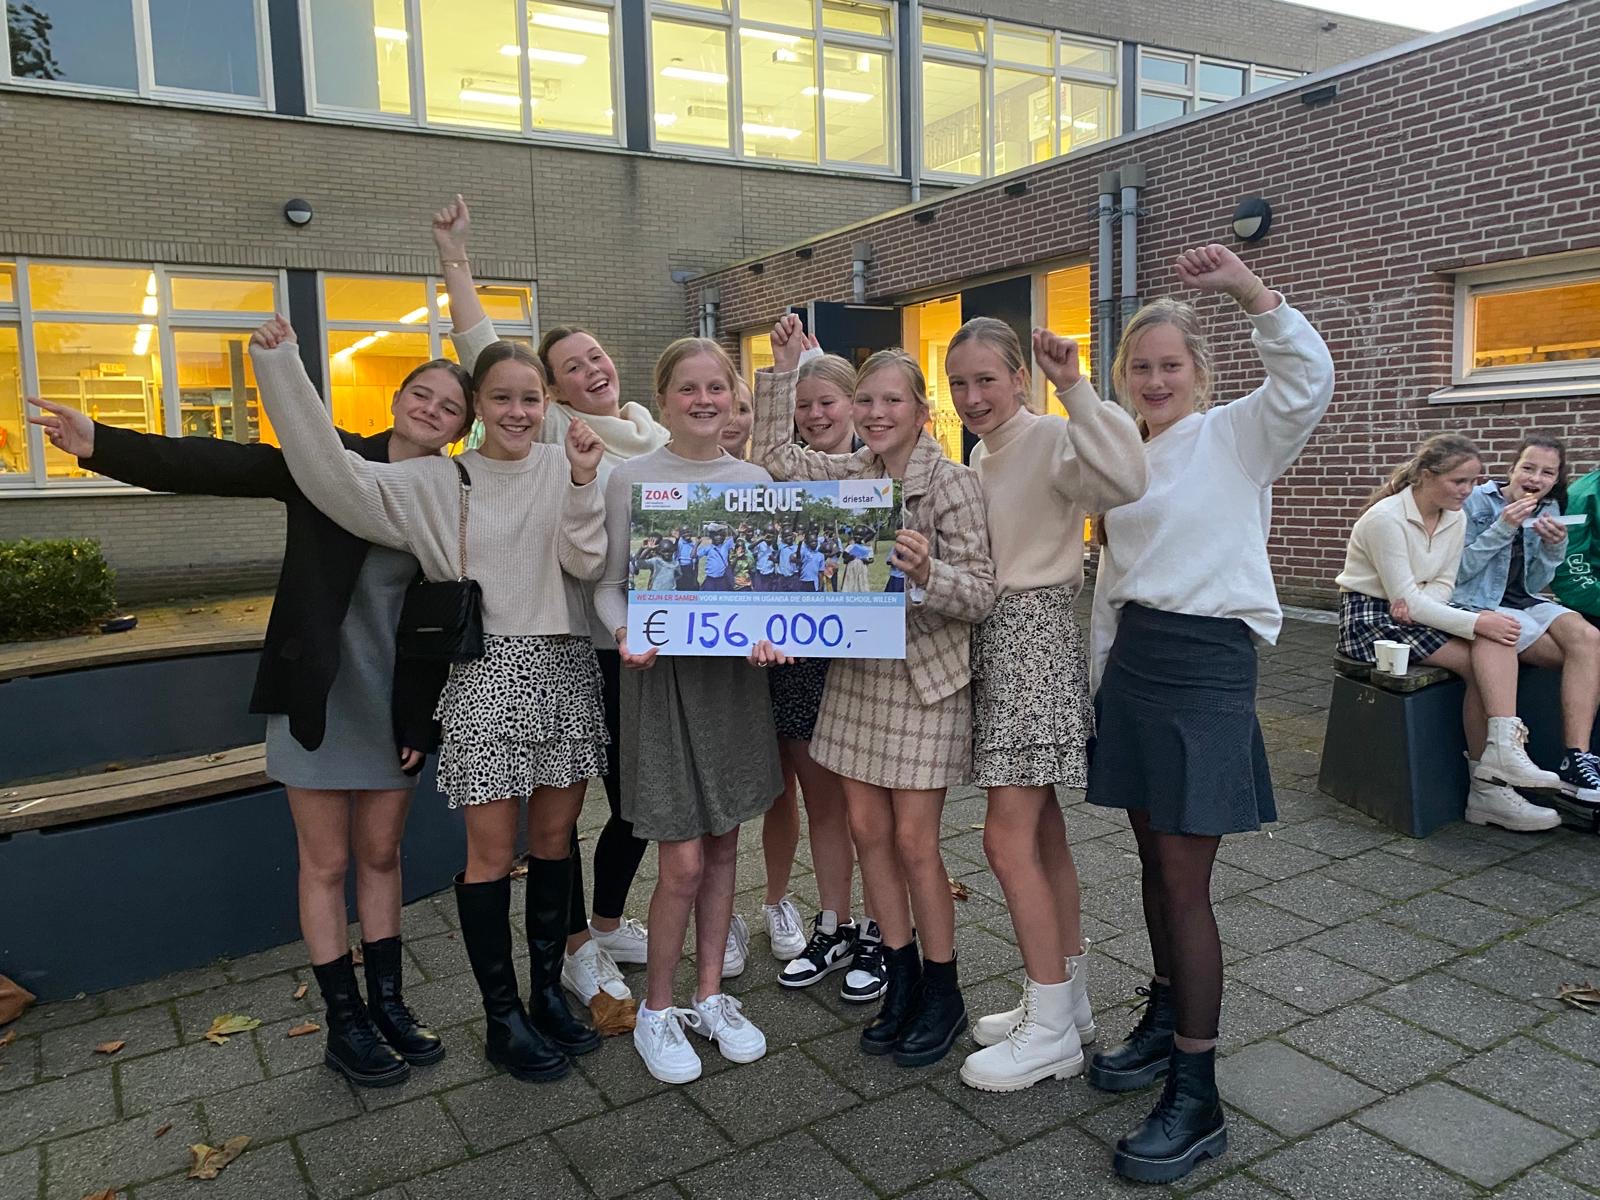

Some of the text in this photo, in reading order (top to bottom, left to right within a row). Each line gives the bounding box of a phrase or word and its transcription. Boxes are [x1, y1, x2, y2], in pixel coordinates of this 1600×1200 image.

[368, 418, 375, 427] 3
[645, 490, 670, 501] ZOA
[842, 494, 875, 504] driestar
[724, 487, 803, 515] CHEQUE
[700, 594, 718, 602] VOOR
[826, 595, 845, 603] NAAR
[846, 595, 872, 603] SCHOOL
[873, 595, 897, 603] WILLEN
[642, 609, 670, 646] €
